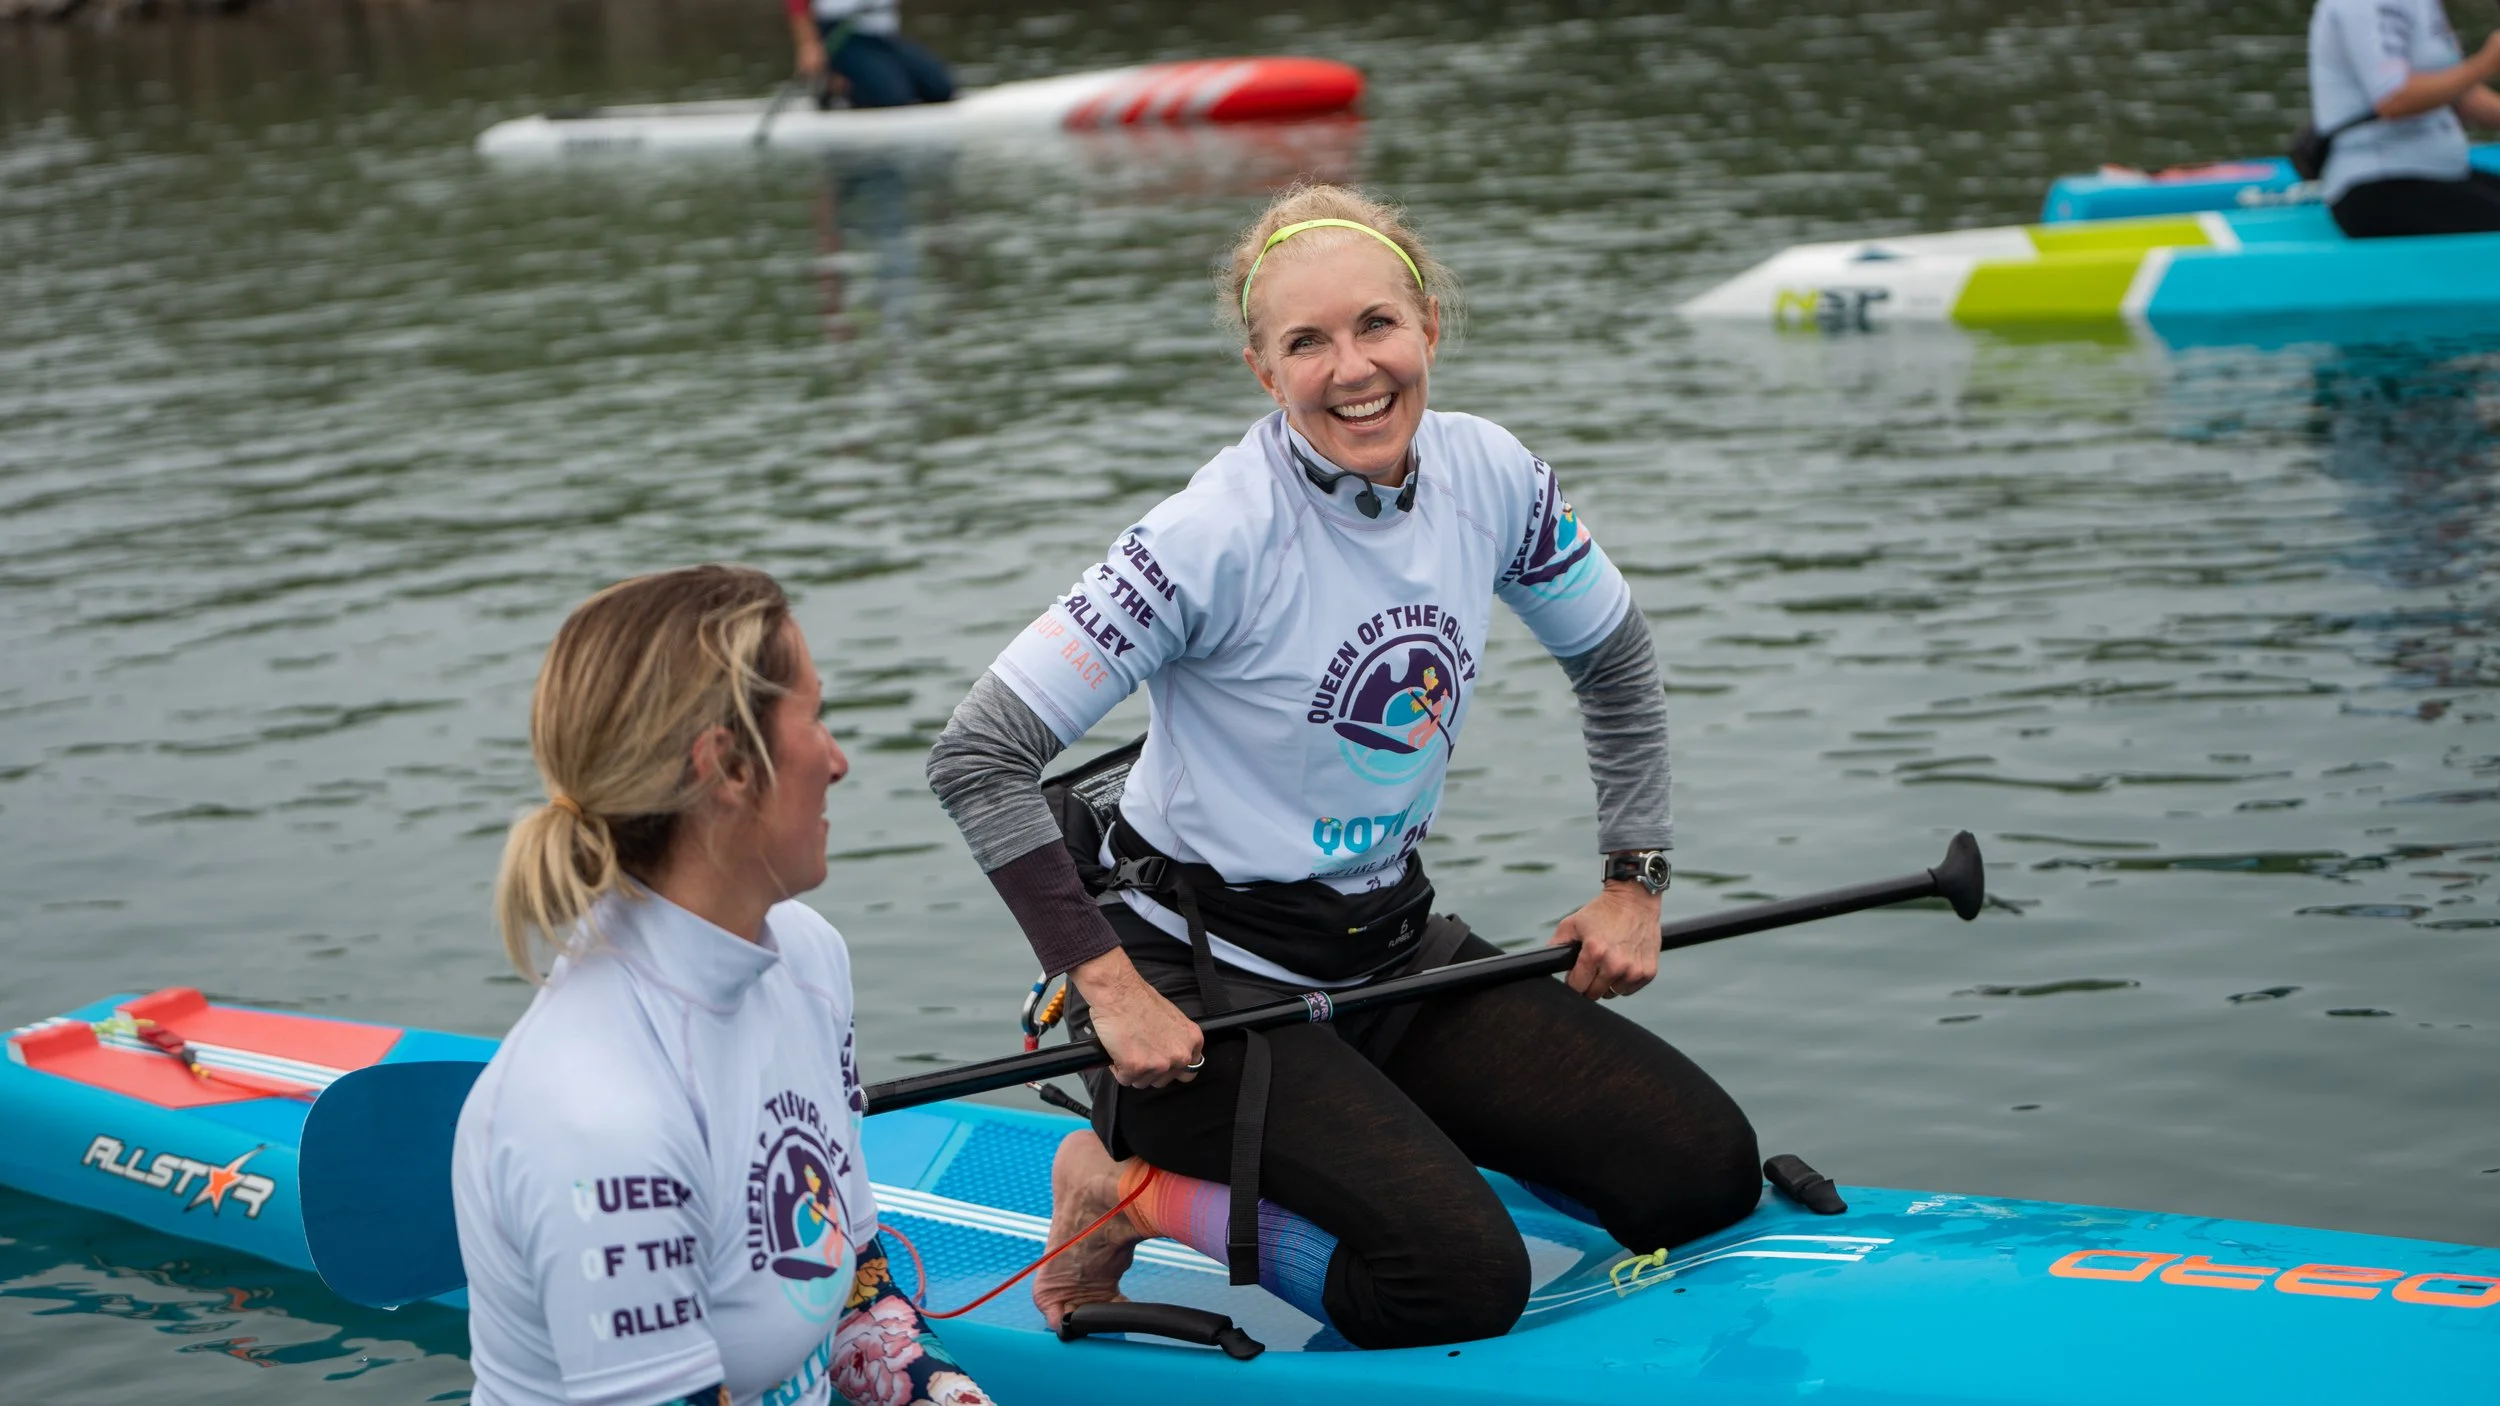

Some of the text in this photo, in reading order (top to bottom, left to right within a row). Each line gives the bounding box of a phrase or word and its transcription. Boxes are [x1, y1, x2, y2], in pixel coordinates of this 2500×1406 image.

[1121, 534, 1177, 602] UEEN
[1064, 594, 1136, 658] ALLEY
[1110, 576, 1155, 630] THE
[1033, 613, 1109, 690] SUP RACE
[1307, 640, 1360, 724] QUEEN
[1357, 613, 1385, 646] OF
[1386, 605, 1439, 630] THE
[636, 1235, 697, 1273] THE
